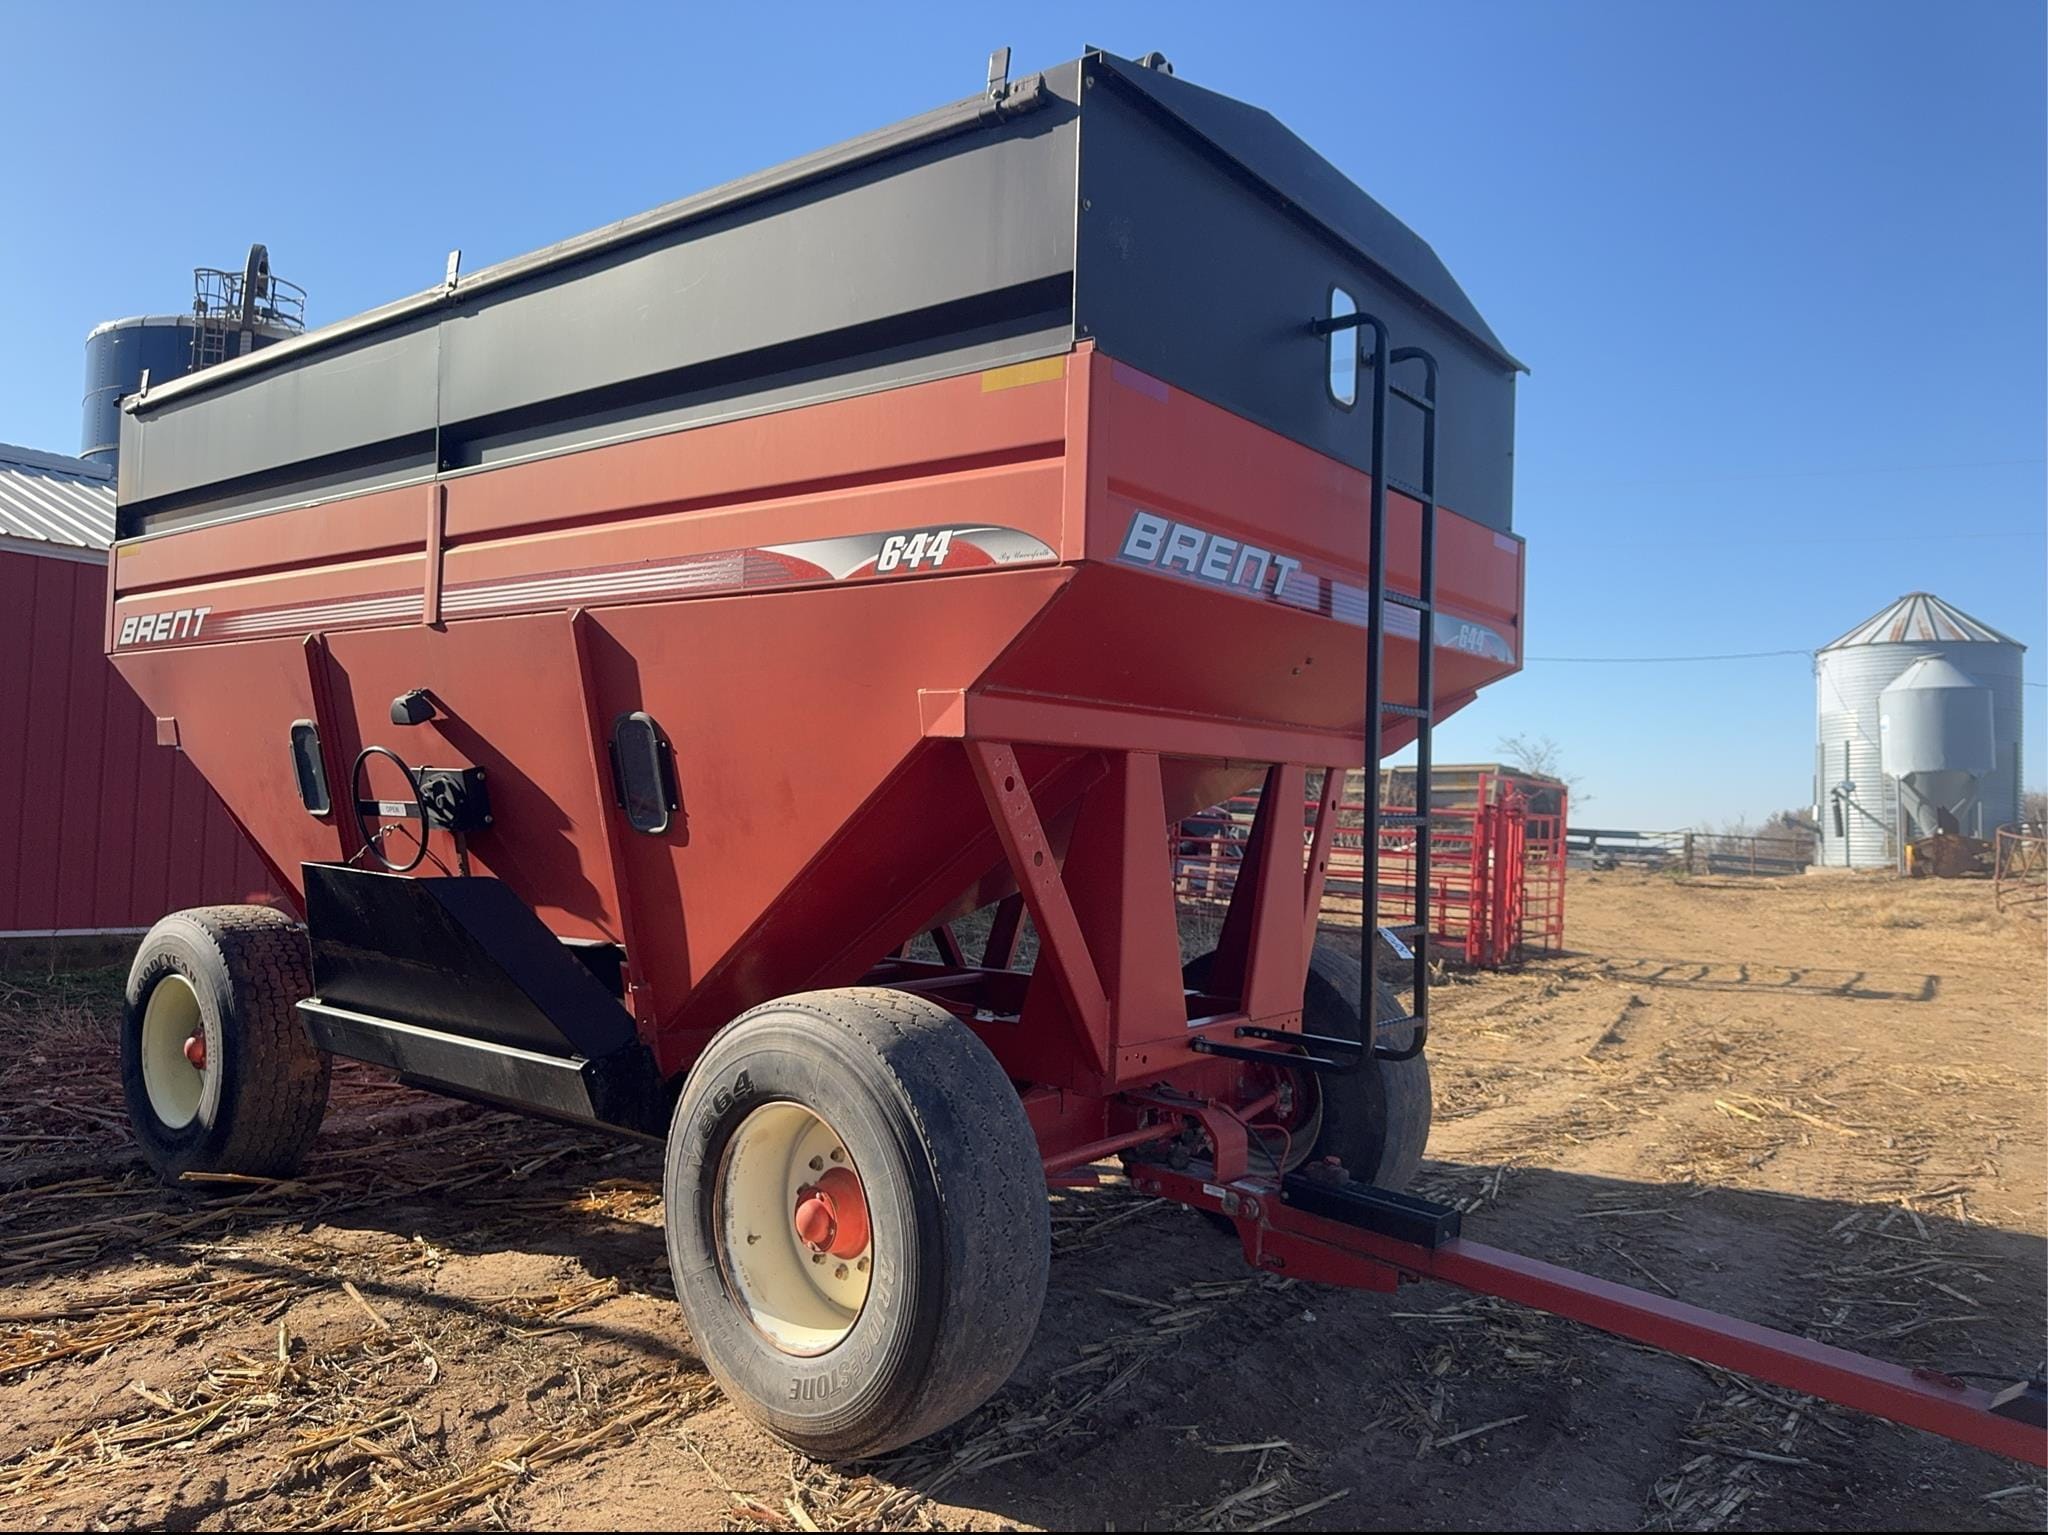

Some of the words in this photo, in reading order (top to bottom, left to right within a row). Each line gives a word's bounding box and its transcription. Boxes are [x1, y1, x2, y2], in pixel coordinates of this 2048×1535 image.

[877, 530, 954, 571] 644
[1122, 511, 1301, 596] BRENT
[118, 606, 212, 645] BRENT
[1459, 624, 1485, 651] 644
[134, 953, 196, 1003] GOODYEAR
[789, 1252, 896, 1400] BRIDGESTONE
